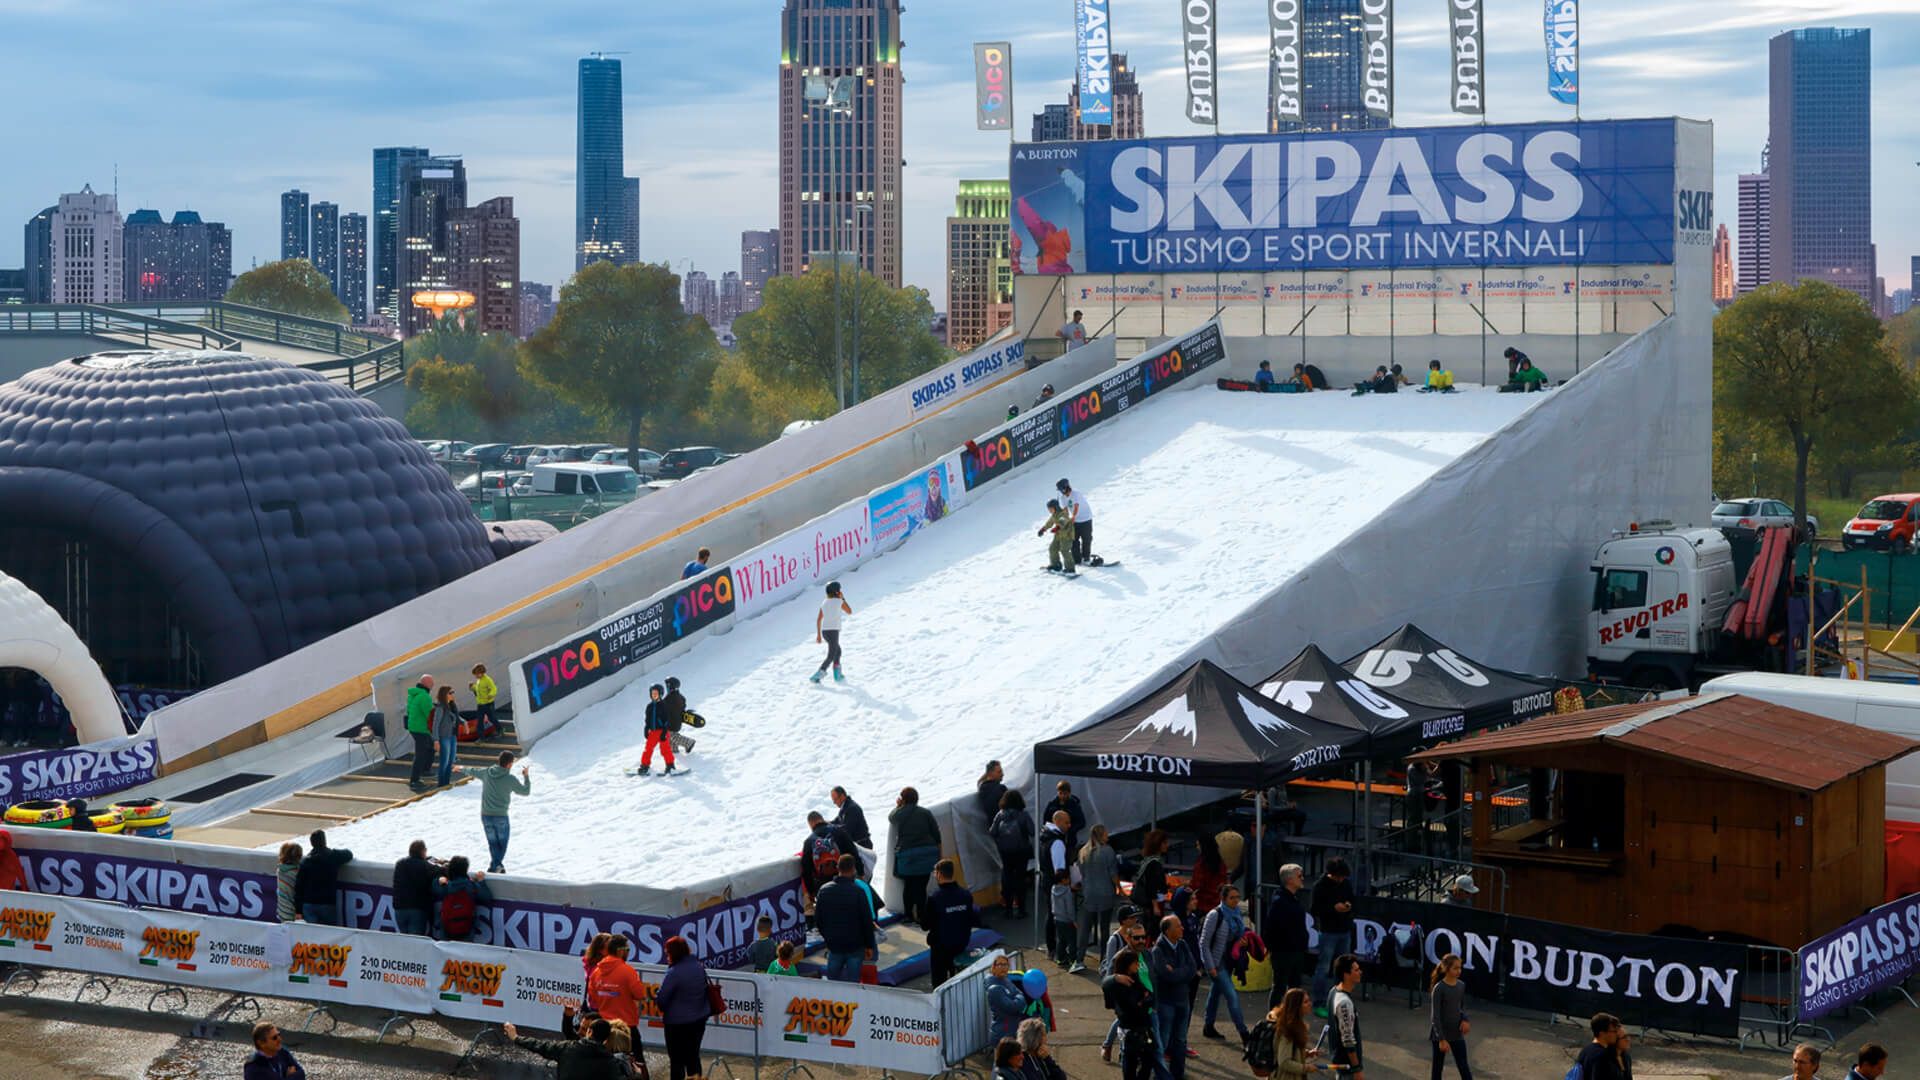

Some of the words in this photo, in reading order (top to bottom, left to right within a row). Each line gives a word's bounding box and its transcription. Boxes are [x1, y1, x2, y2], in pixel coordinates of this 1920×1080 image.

[1028, 148, 1078, 160] BURTON
[1110, 131, 1584, 233] SKIPASS
[1111, 236, 1250, 265] TURISMO
[1264, 236, 1279, 262] E
[1291, 232, 1392, 261] SPORT
[1405, 229, 1585, 259] INVERNALI
[1095, 286, 1129, 294] Indutrial
[1280, 283, 1316, 292] Indusrial
[912, 373, 956, 408] SKIPASS
[962, 351, 1003, 384] SKIPASS
[736, 554, 798, 604] White
[803, 552, 811, 570] is
[813, 506, 869, 578] funny!
[600, 615, 636, 640] GUARDA
[1599, 592, 1688, 645] REVOTRA
[609, 639, 618, 653] LE
[619, 629, 636, 647] TUE
[637, 616, 663, 639] FOTO!
[1512, 694, 1543, 715] BURTON
[21, 741, 154, 792] SKIPASS
[1097, 753, 1192, 776] BURTON
[1290, 744, 1342, 772] BURTON
[67, 785, 73, 795] E
[74, 780, 105, 793] SPORT
[95, 862, 264, 918] SKIPASS
[64, 934, 84, 945] 2017
[83, 924, 126, 939] DICEMBRE
[209, 953, 229, 965] 2017
[1805, 912, 1906, 997] SKIPASS
[381, 958, 428, 975] DICEMBRE
[1510, 939, 1739, 1008] BURTON
[360, 969, 381, 981] 2017
[384, 972, 426, 988] BOLOGNA
[537, 978, 582, 995] DICEMBRE
[1842, 982, 1849, 997] E
[1849, 971, 1874, 993] SPORT
[516, 989, 537, 1001] 2017
[713, 1012, 764, 1026] OLOGNA
[870, 1028, 894, 1041] 2017
